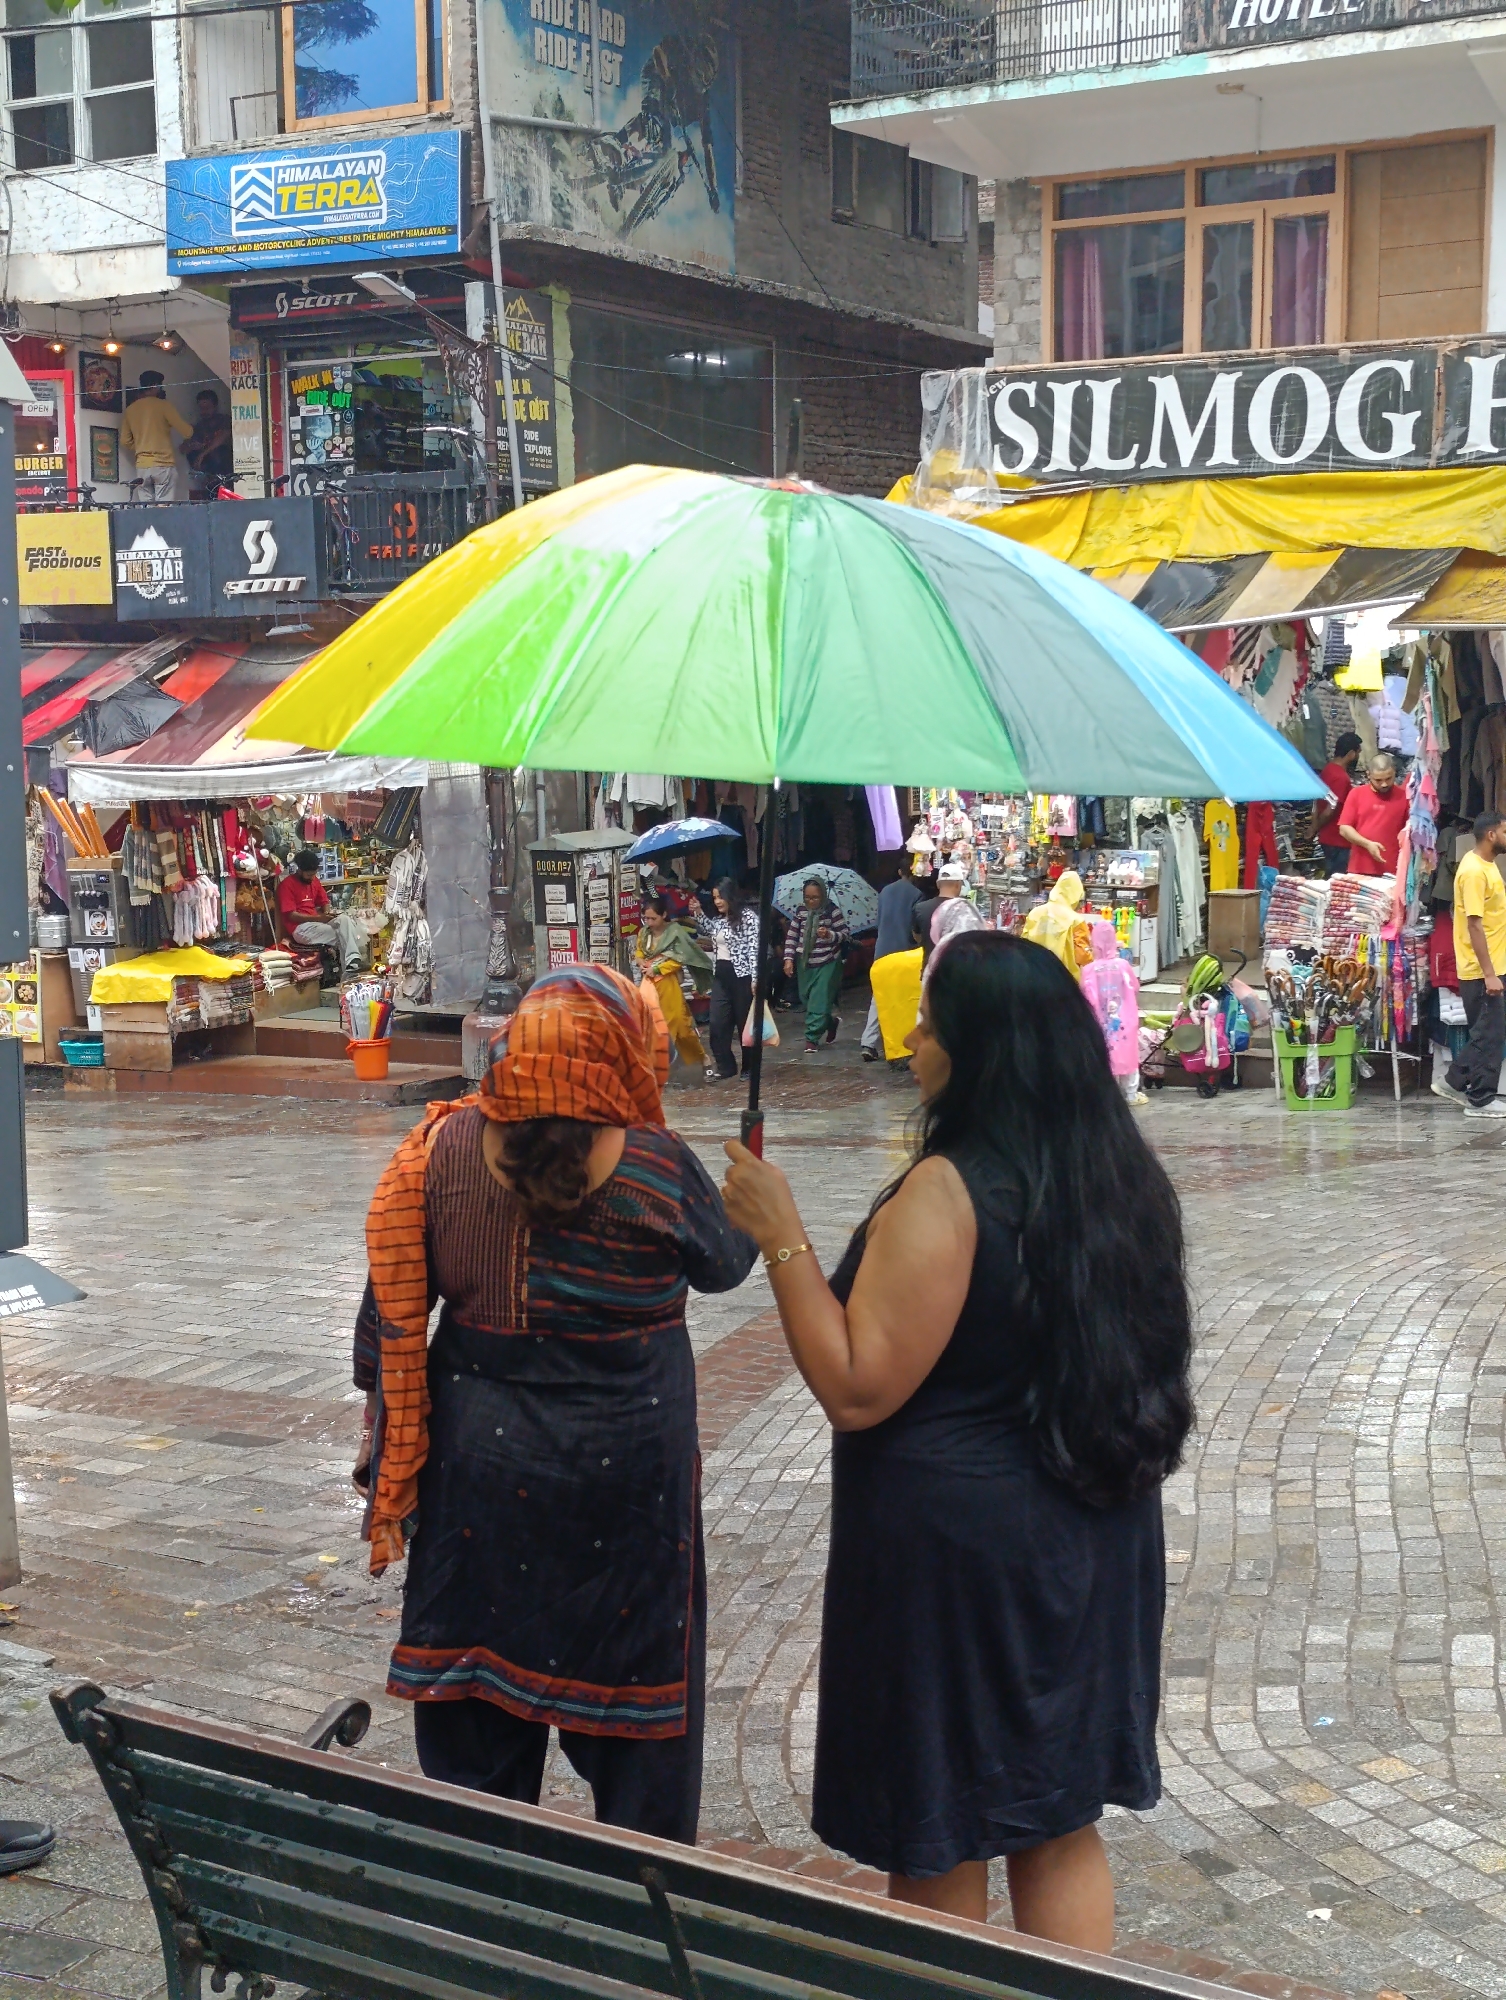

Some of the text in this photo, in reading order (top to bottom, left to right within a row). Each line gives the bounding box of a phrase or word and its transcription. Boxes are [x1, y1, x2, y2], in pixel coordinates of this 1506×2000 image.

[578, 0, 626, 47] HRD
[534, 27, 624, 88] RIDE FST
[277, 158, 381, 184] HIMALAYAN
[276, 177, 381, 213] TERRA
[238, 243, 253, 252] AND
[253, 239, 306, 251] MOTORCYCLING
[353, 234, 361, 243] IN
[362, 232, 376, 242] THE
[376, 229, 405, 240] MIGHTY
[405, 226, 447, 239] HIMALAYAS
[290, 292, 358, 310] SCOTT
[493, 314, 546, 335] HALAYAN
[493, 327, 547, 357] BKEBAR
[231, 359, 253, 375] RIDE
[231, 376, 259, 390] RACE
[291, 373, 320, 395] WALK
[495, 379, 520, 395] WK
[331, 391, 352, 408] OUT
[27, 404, 49, 413] OPEN
[232, 405, 260, 421] TRAIL
[528, 396, 550, 421] OUT
[992, 359, 1422, 474] SILMOG
[496, 426, 540, 442] BU RIDE
[496, 440, 553, 457] RE EXPLORE
[14, 456, 64, 471] BURGER
[25, 546, 62, 562] FAST
[115, 549, 182, 561] HIMALAYAN
[28, 556, 102, 572] FOODIOUS
[223, 576, 308, 596] SCOTT
[550, 950, 577, 964] HOTEL
